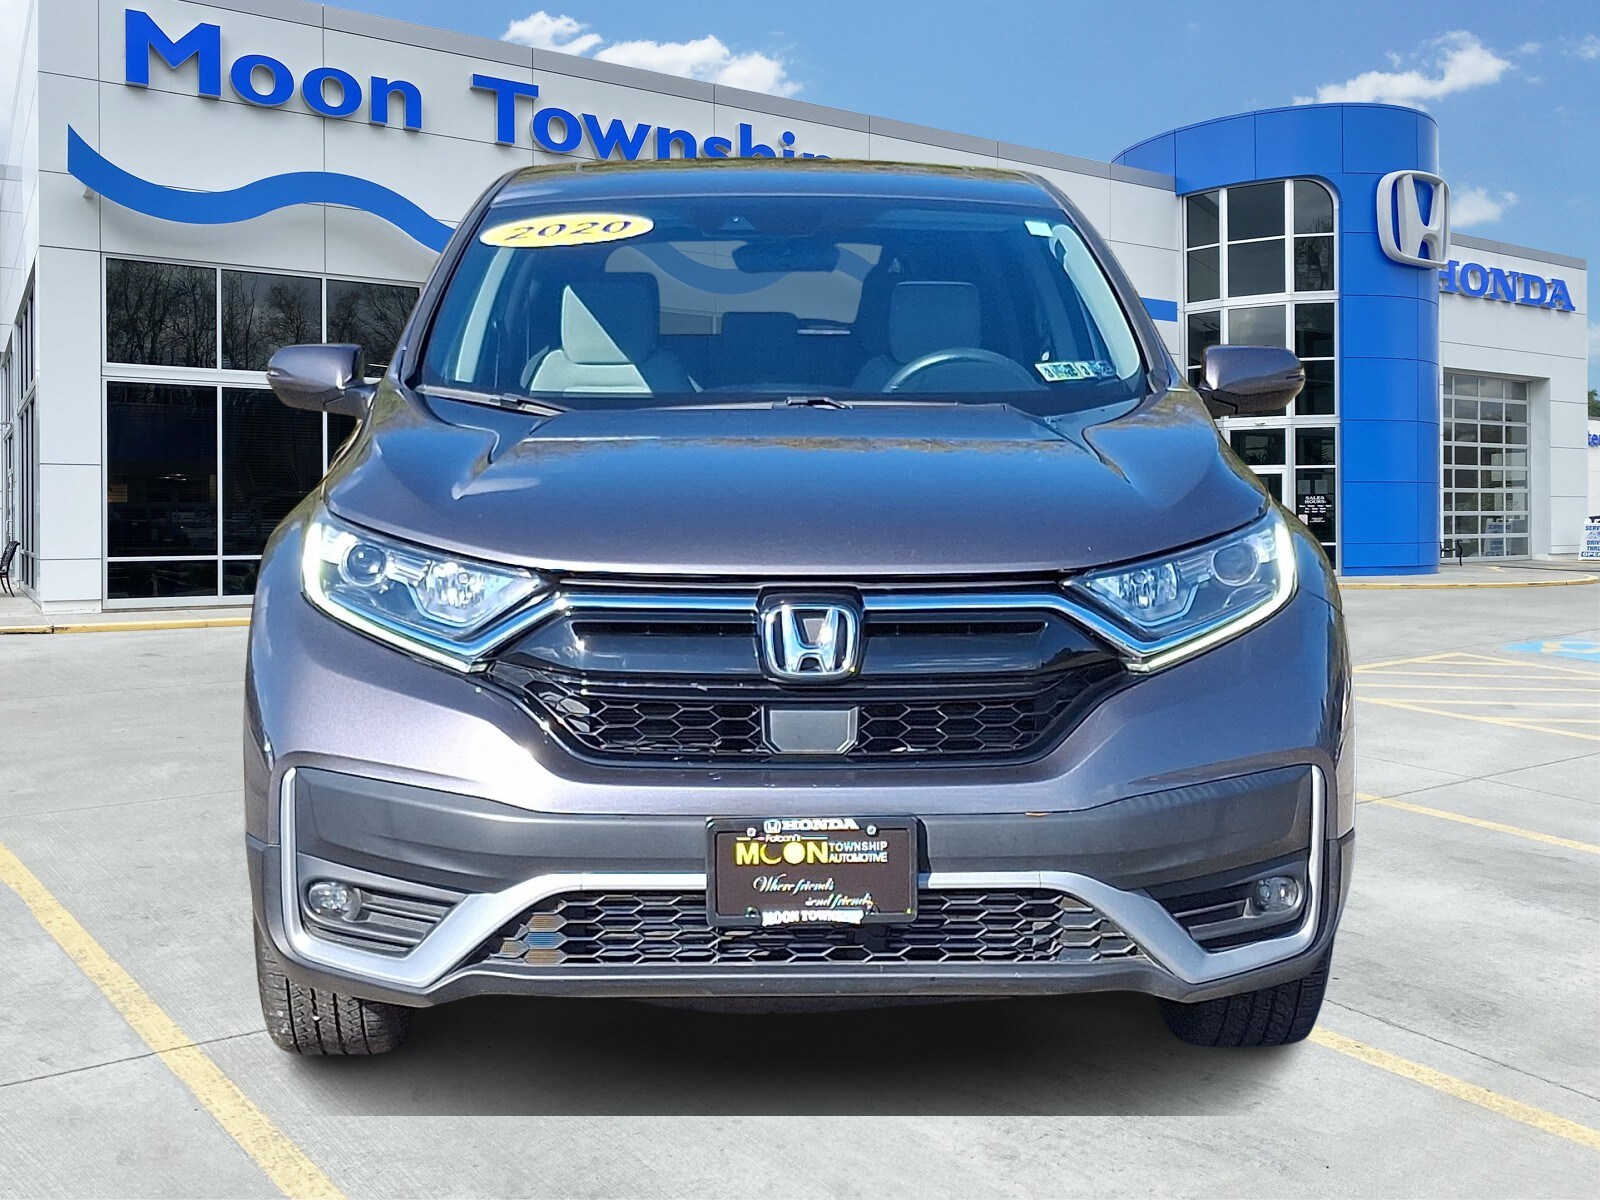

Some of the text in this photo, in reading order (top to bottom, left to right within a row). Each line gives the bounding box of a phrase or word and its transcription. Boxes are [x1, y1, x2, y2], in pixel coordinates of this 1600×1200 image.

[125, 9, 832, 161] Moon Townshi
[504, 221, 632, 241] 2020
[1438, 259, 1576, 311] HONDA
[781, 818, 860, 832] HONDA
[736, 842, 829, 866] MOON
[829, 841, 888, 851] TOWNSHIP
[829, 852, 888, 863] AUTOMOTIVE
[791, 877, 835, 896] friends
